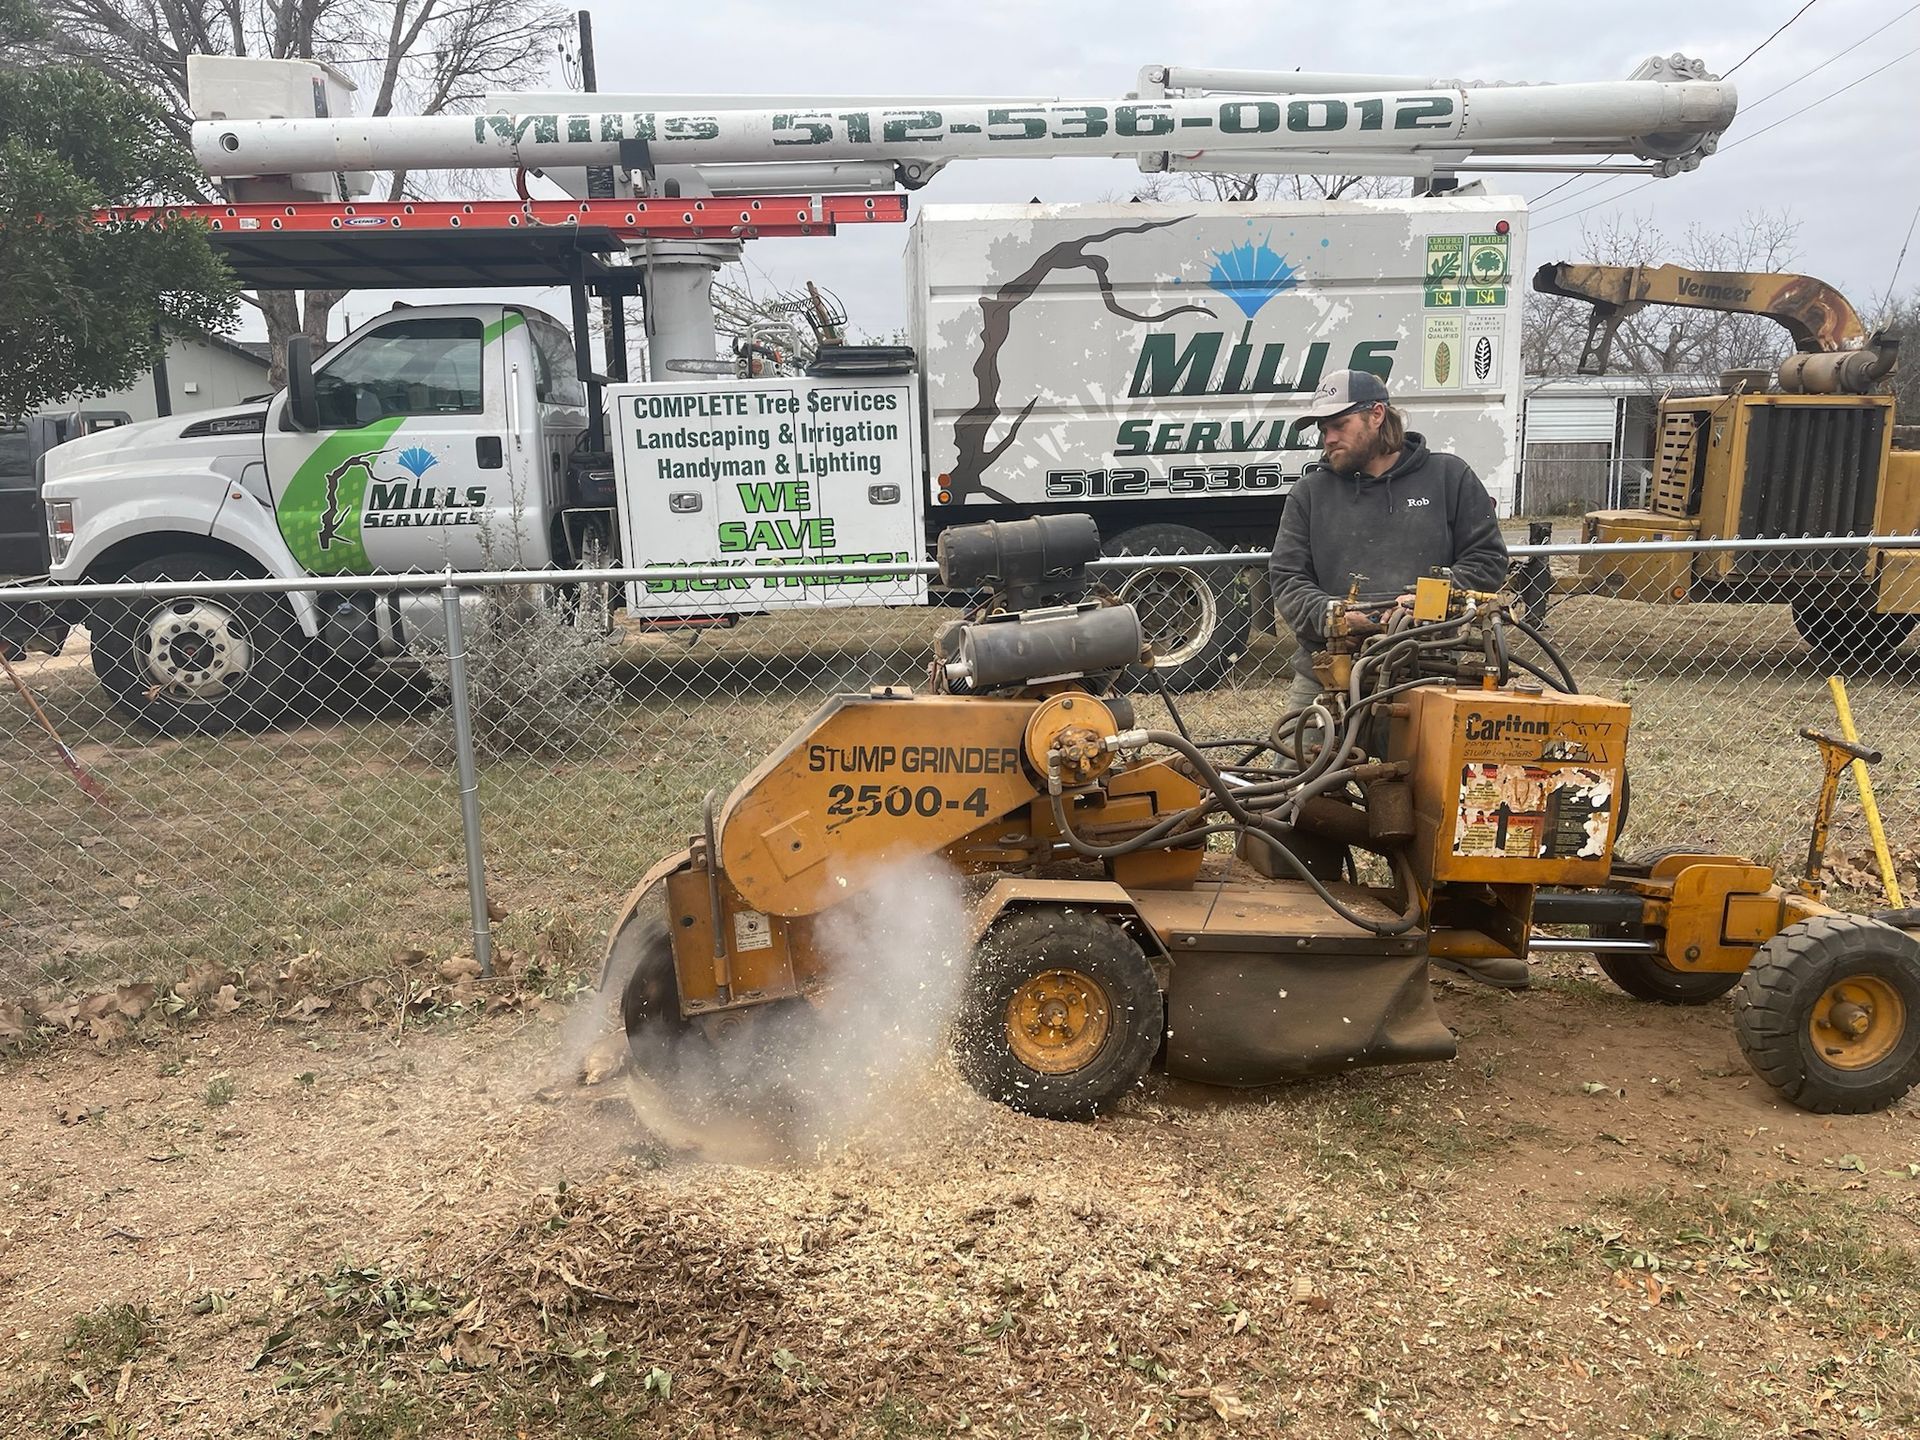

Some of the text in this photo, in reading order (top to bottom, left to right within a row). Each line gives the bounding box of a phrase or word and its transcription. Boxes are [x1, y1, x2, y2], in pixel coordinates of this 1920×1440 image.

[773, 97, 1455, 146] 512-536-0012
[1470, 236, 1507, 244] MEMBER
[1435, 292, 1452, 305] ISA
[1476, 290, 1495, 304] ISA
[1678, 276, 1753, 302] Vermeer
[634, 390, 897, 419] COMPLETE Tree Services
[636, 421, 898, 450] Landscaping & Irrigation
[657, 451, 881, 481] Handyman & Lighting
[369, 484, 488, 511] MILLS
[737, 481, 811, 513] WE
[1407, 498, 1430, 507] Rob
[719, 518, 836, 552] SAVE
[1466, 713, 1549, 741] Carlton
[809, 745, 1018, 773] STUMP GRINDER
[827, 784, 989, 817] 2500-4
